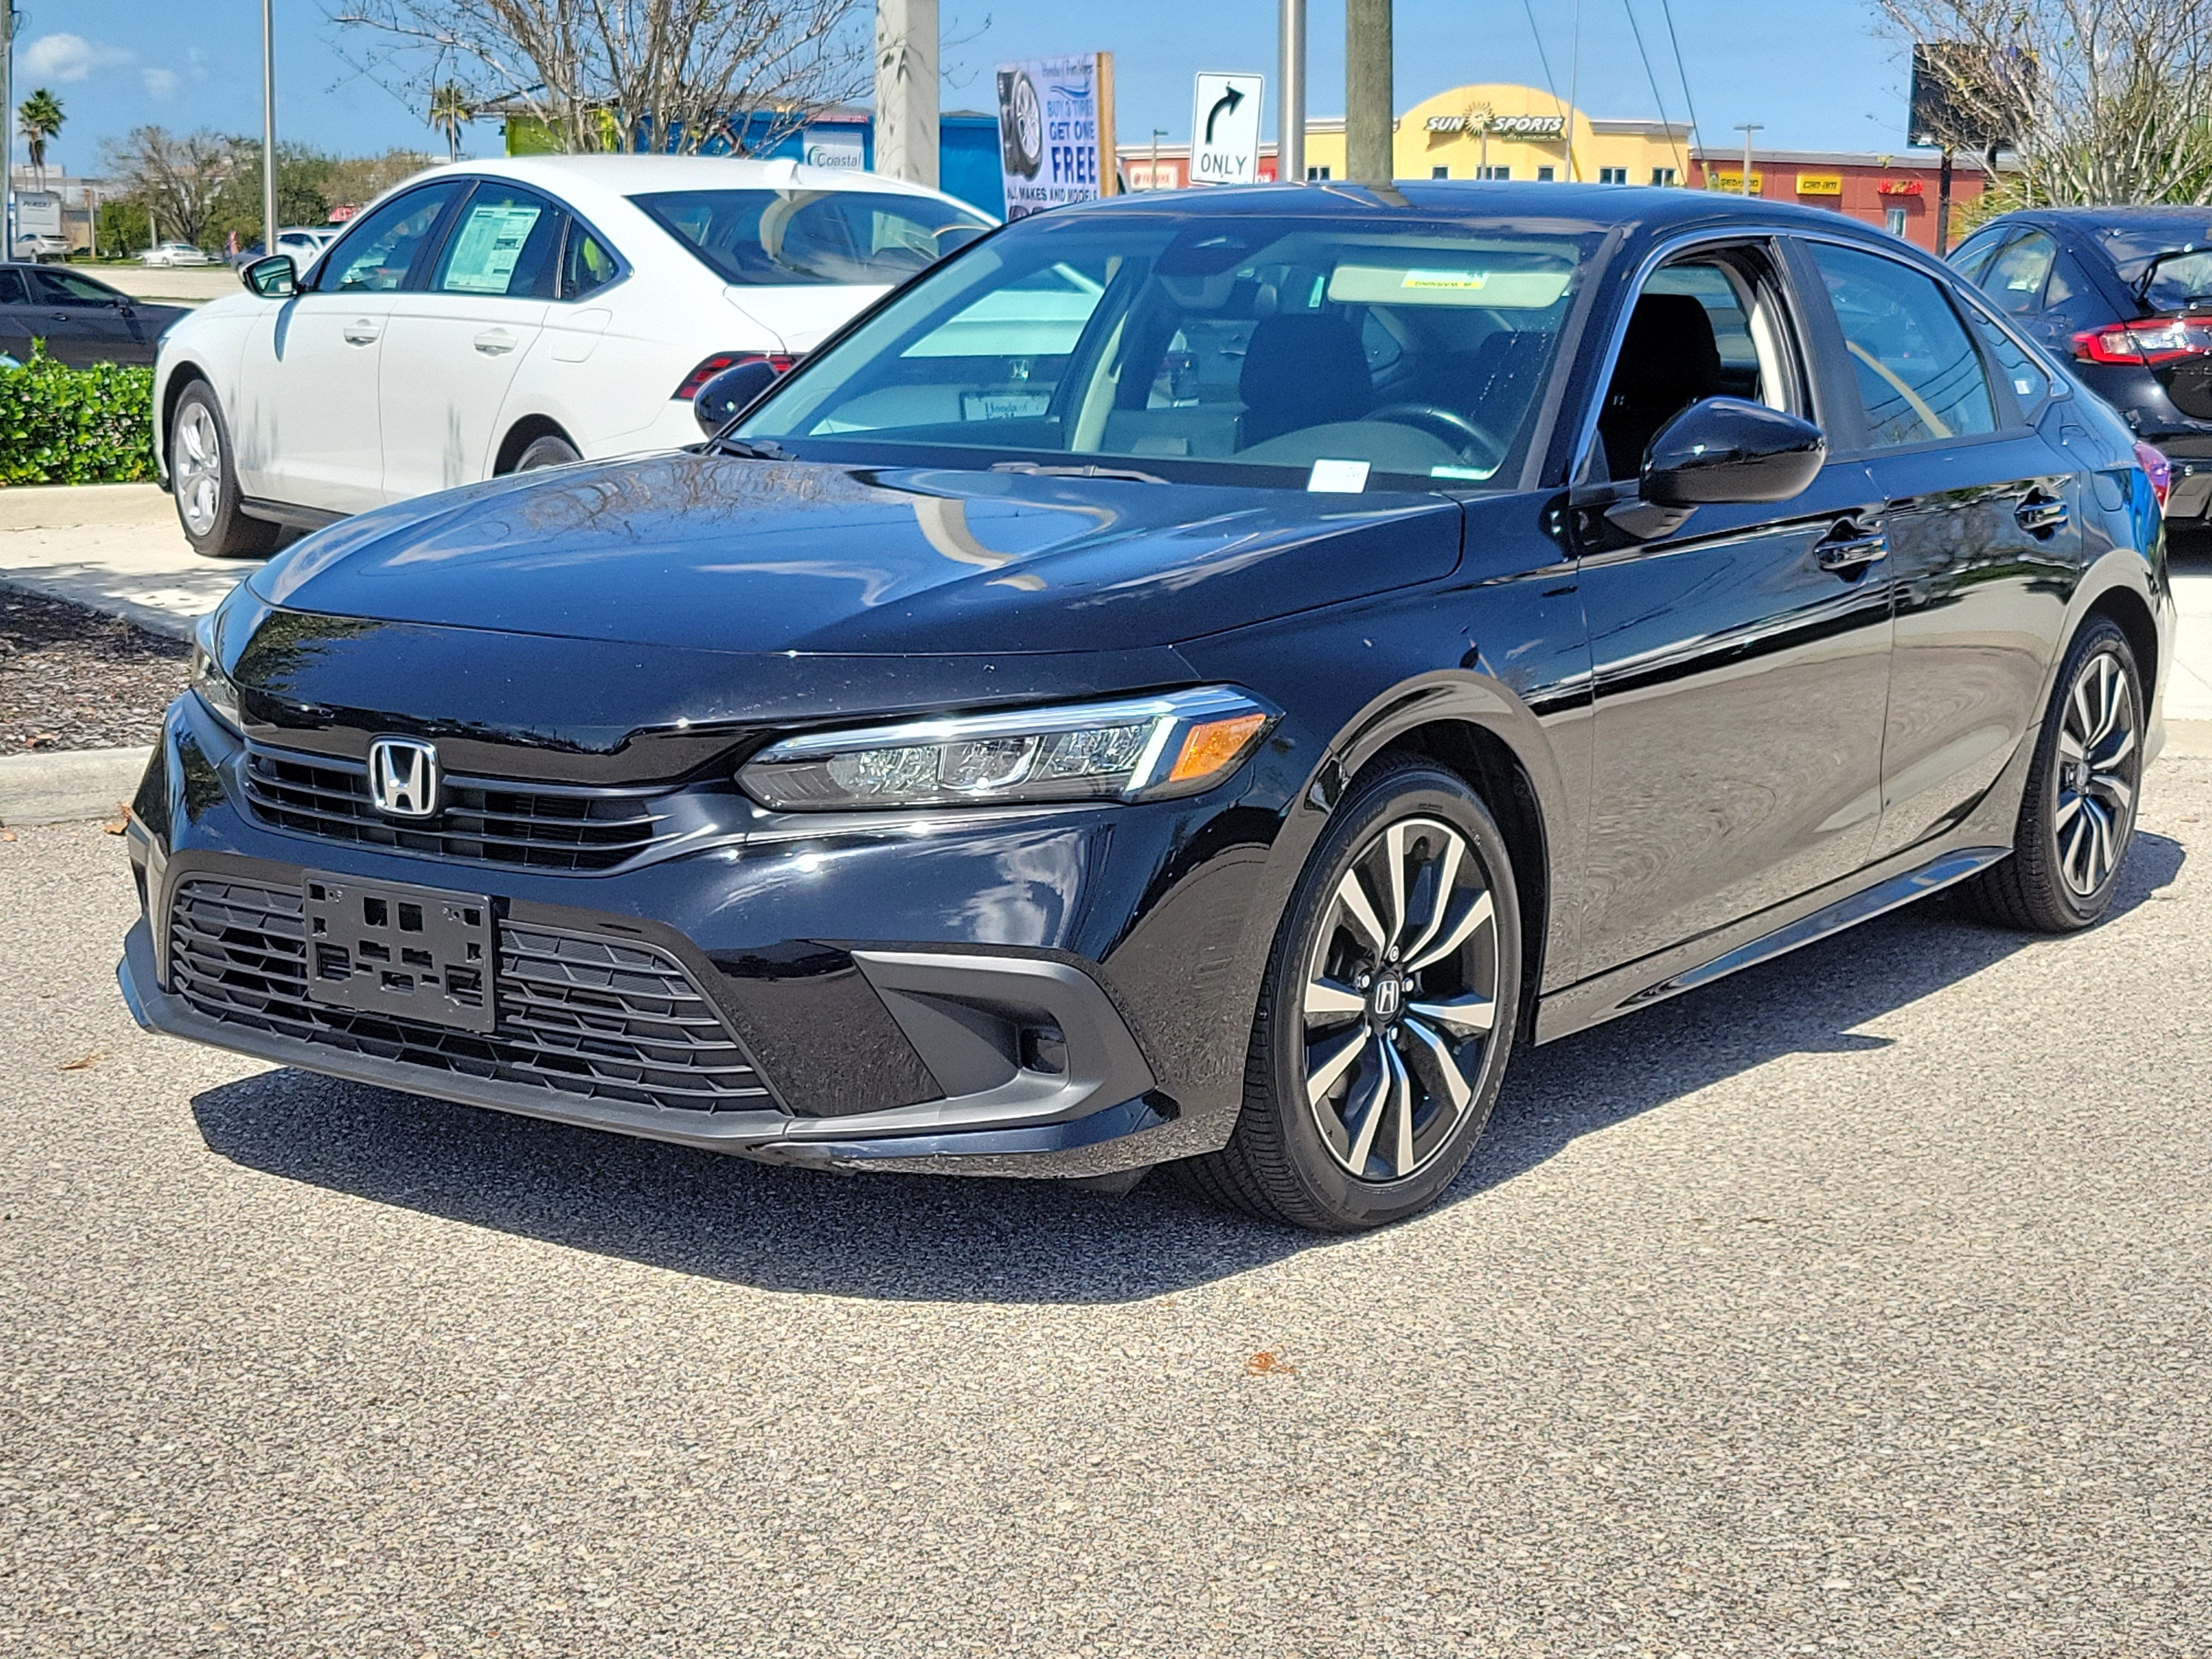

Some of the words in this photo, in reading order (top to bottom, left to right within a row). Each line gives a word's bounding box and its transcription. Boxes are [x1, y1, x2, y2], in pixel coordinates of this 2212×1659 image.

[1049, 122, 1070, 141] GET
[1074, 120, 1094, 141] ONE
[1426, 116, 1466, 131] SUN
[1491, 117, 1563, 132] SPORTS
[817, 151, 861, 167] Coastal
[1051, 146, 1096, 184] FREE
[1201, 153, 1248, 176] ONLY
[1019, 187, 1047, 201] MAKES
[1050, 188, 1066, 202] AND
[1067, 189, 1097, 204] MODELS
